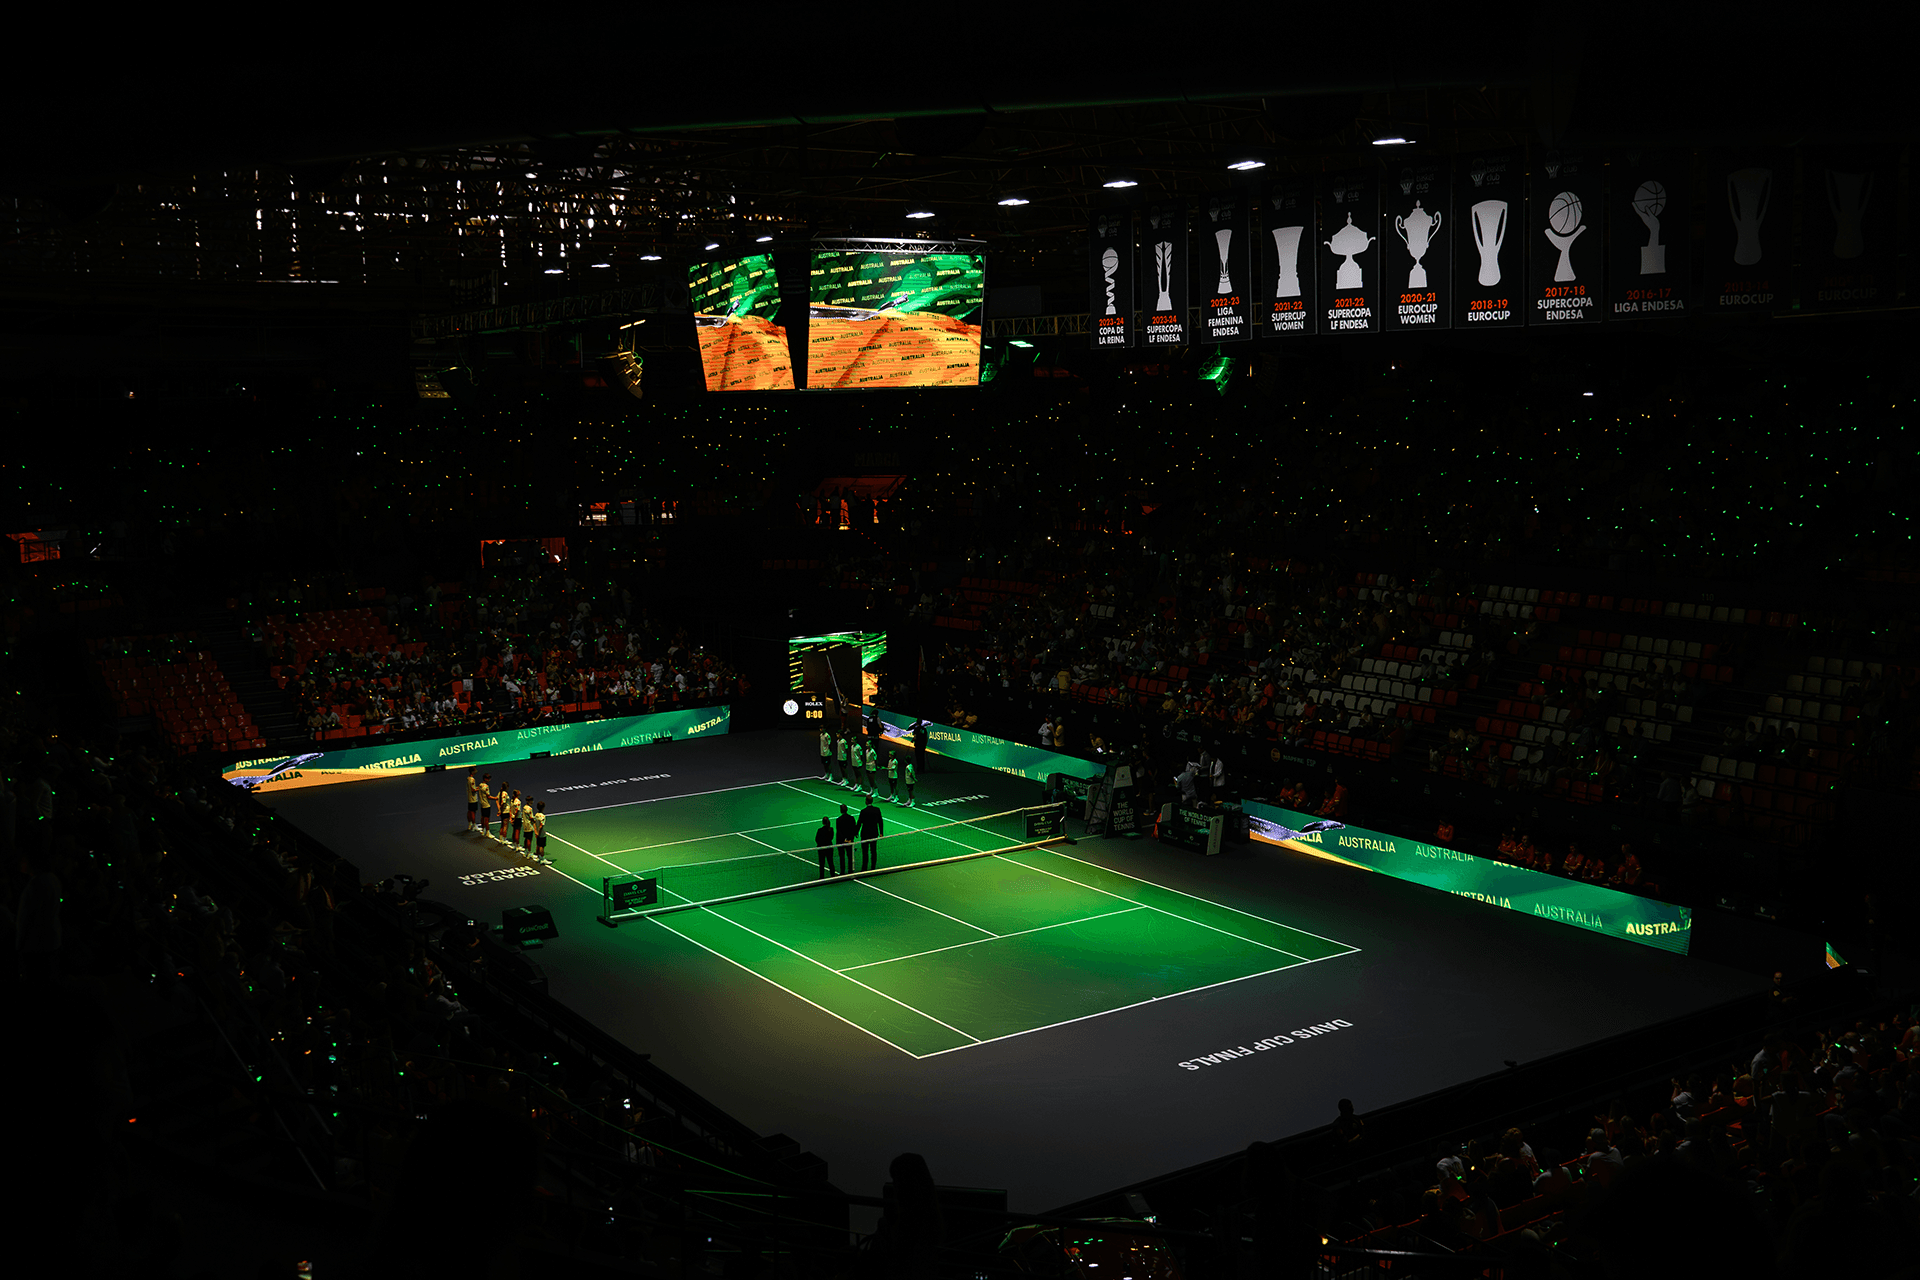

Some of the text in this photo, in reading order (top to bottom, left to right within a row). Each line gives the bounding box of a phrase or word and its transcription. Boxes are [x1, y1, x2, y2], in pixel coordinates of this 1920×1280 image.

[890, 258, 915, 266] AUSTRALIA
[830, 266, 854, 274] AUSTRALIA
[848, 279, 872, 288] AUSTRALIA
[878, 276, 902, 284] AUSTRALIA
[1544, 285, 1586, 298] 2017-18
[1724, 280, 1770, 294] 2013-14
[1400, 292, 1436, 304] 2020-21
[1626, 288, 1672, 300] 2016-17
[1719, 293, 1774, 306] EUROCUP
[1818, 287, 1878, 302] EUROCUP
[1210, 296, 1240, 308] 2022-23
[1274, 302, 1304, 312] 2021-22
[1334, 298, 1365, 308] 2021-22
[1470, 299, 1508, 310] 2018-19
[1536, 297, 1594, 310] SUPERCOPA
[1614, 300, 1684, 313] LIGA ENDESA
[1217, 307, 1234, 316] LIGA
[1328, 308, 1372, 319] SUPERCOPA
[1398, 304, 1438, 315] EUROCUP
[1546, 310, 1584, 320] ENDESA
[1098, 317, 1124, 326] 2023-24
[1152, 314, 1178, 324] 2023-24
[1271, 311, 1306, 322] SUPERCUP
[1400, 314, 1436, 324] WOMEN
[1467, 310, 1511, 322] EUROCUP
[1208, 316, 1244, 328] FEMENINA
[1274, 321, 1304, 331] WOMEN
[1330, 319, 1368, 330] LF ENDESA
[1099, 326, 1124, 336] COPA DE
[1146, 324, 1183, 334] SUPERCOPA
[1212, 326, 1240, 336] ENDESA
[1098, 335, 1125, 344] LA REINA
[1148, 333, 1181, 343] LF ENDESA
[858, 344, 882, 352] AUSTRALIA
[806, 710, 823, 718] 0:00
[517, 723, 570, 740] AUSTRALIA
[929, 732, 962, 742] AUSTRALIA
[972, 734, 1005, 746] AUSTRALIA
[438, 736, 498, 758] AUSTRALIA
[1282, 754, 1316, 767] MAPFRE ESP
[1117, 801, 1129, 809] THE
[1113, 808, 1134, 817] WORLD
[1114, 814, 1134, 824] CUP OF
[1114, 822, 1136, 831] TENNIS
[1338, 836, 1396, 854] AUSTRALIA
[1415, 844, 1474, 862] AUSTRALIA
[458, 866, 533, 881] MALAGA
[462, 869, 541, 886] ROAD TO
[1534, 902, 1603, 929] AUSTRALIA
[1178, 1018, 1354, 1071] DAVIS CUP FINALS
